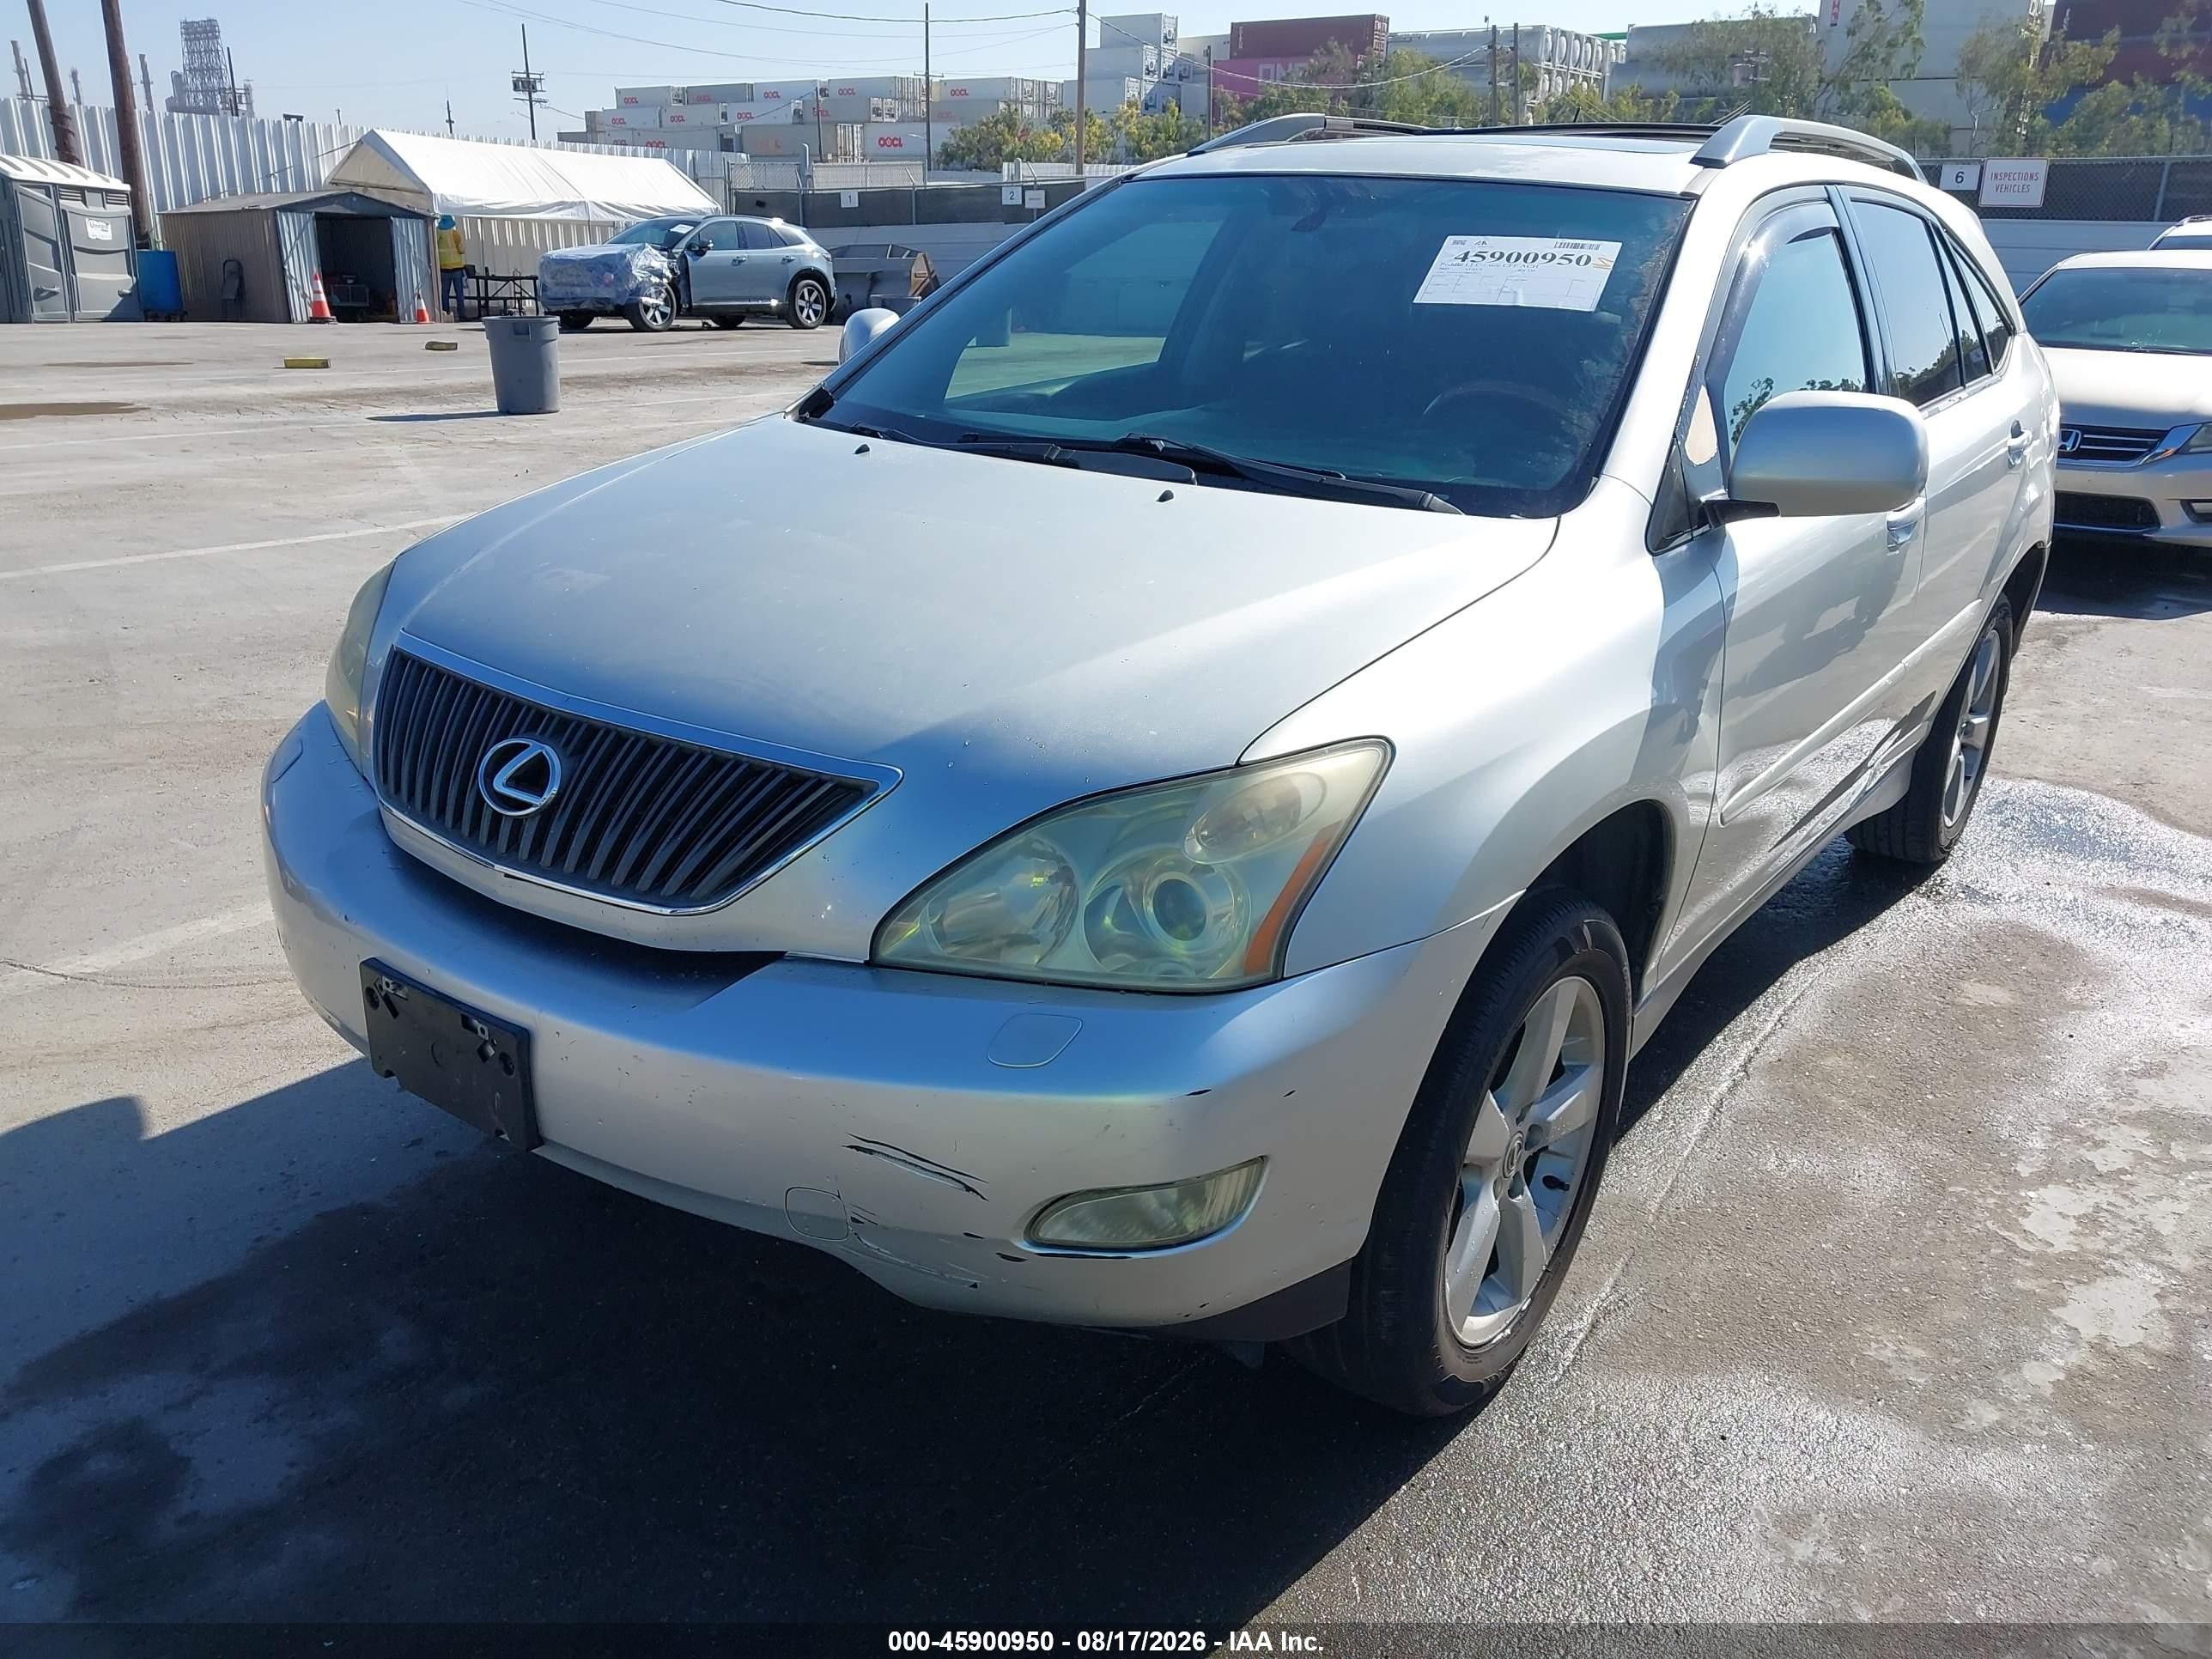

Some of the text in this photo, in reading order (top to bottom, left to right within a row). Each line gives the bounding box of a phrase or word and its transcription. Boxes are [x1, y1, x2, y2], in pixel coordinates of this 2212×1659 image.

[763, 91, 781, 100] OOCL
[838, 88, 856, 96] OOCL
[623, 96, 639, 105] OOCL
[611, 117, 626, 125] OOCL
[736, 112, 755, 121] OOCL
[878, 137, 902, 148] OOCL
[1954, 171, 1965, 184] 6
[1990, 171, 2039, 182] INSPECTIONS
[1995, 184, 2031, 193] VEHICLES
[1009, 191, 1015, 200] 2
[1453, 250, 1592, 266] 45900950
